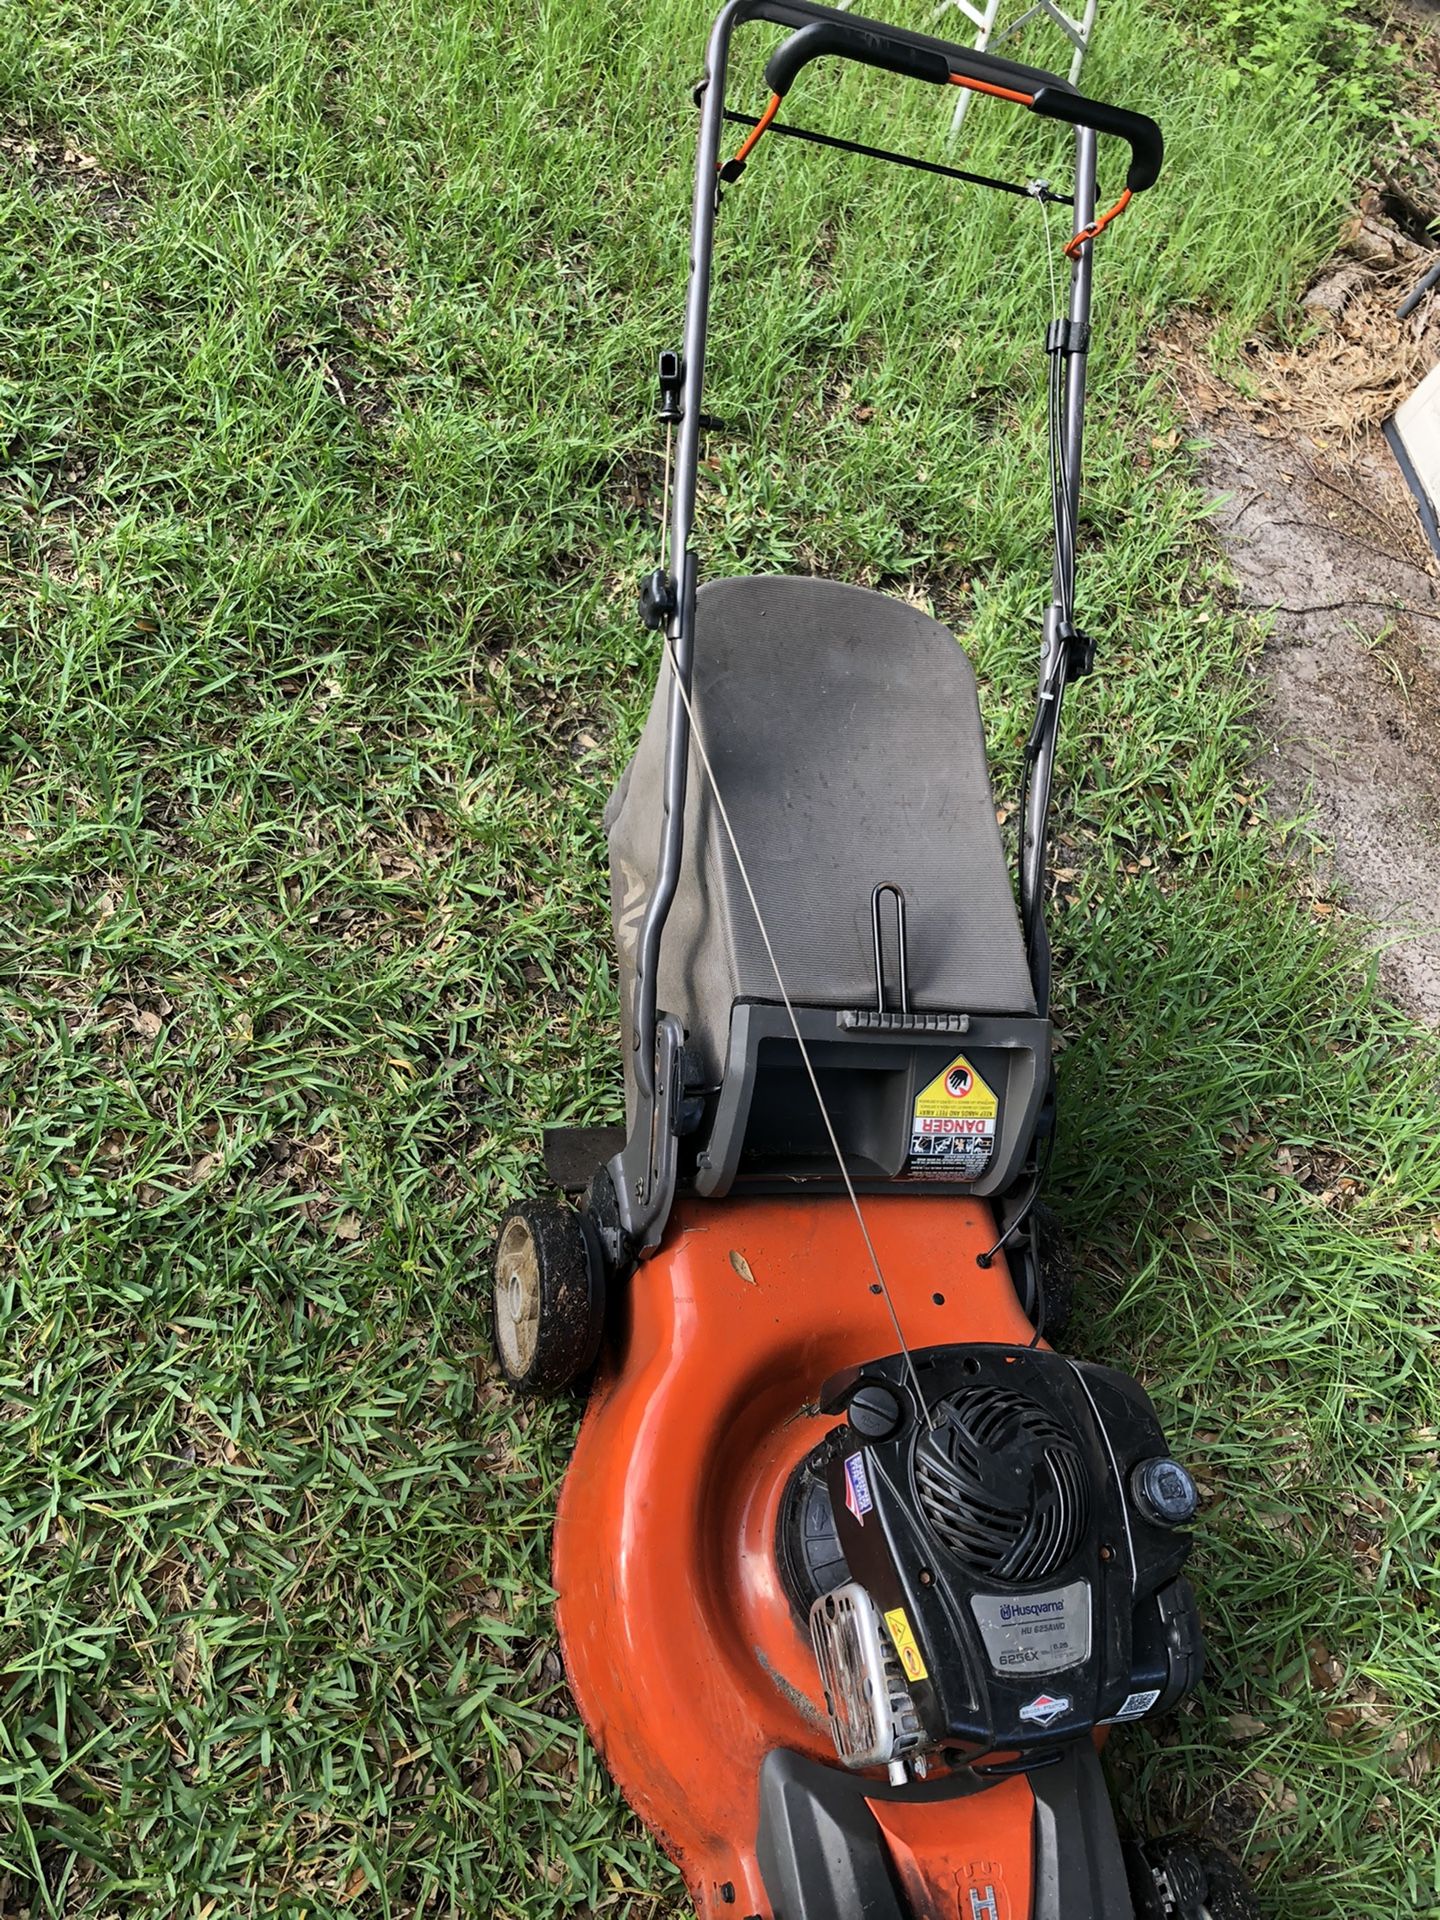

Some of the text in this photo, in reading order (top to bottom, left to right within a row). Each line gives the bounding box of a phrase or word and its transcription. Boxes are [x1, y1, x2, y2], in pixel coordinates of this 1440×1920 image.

[922, 1118, 986, 1133] DANGER
[1011, 1601, 1064, 1616] Husqvarna
[1021, 1622, 1066, 1635] HU 625AWD
